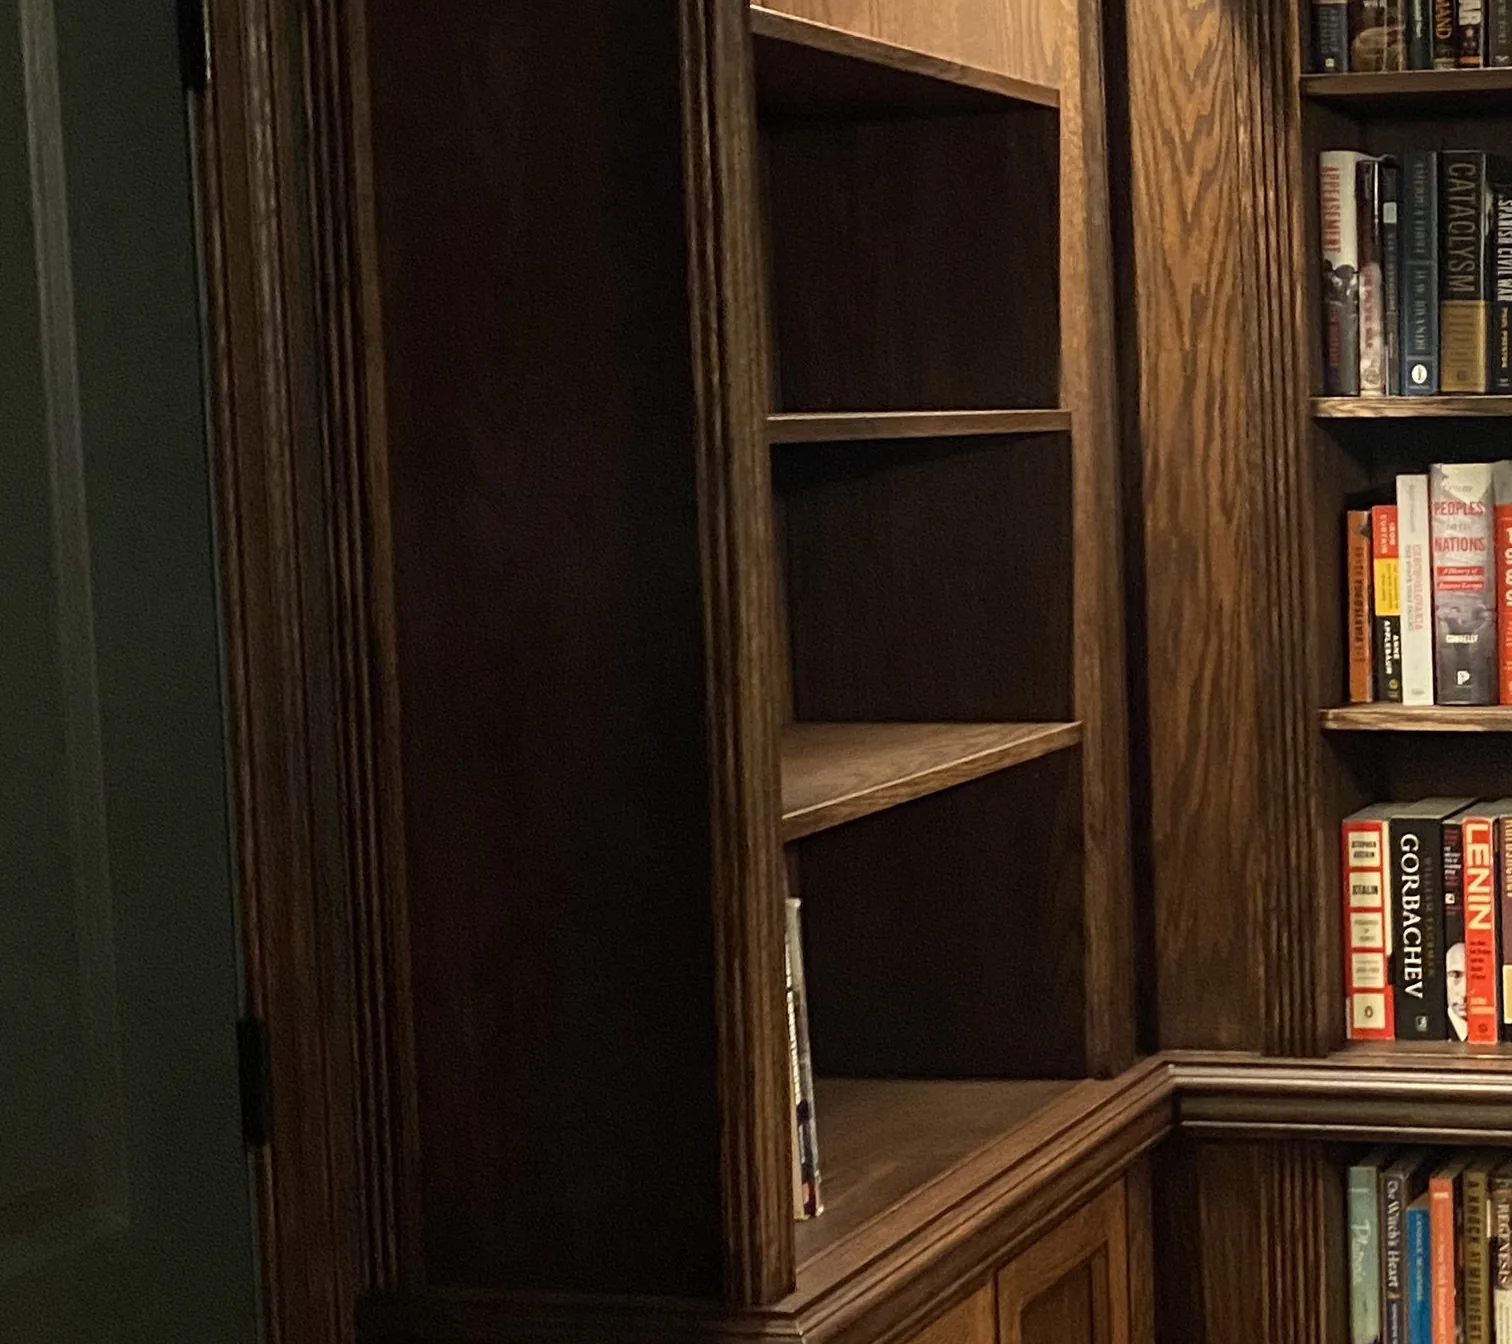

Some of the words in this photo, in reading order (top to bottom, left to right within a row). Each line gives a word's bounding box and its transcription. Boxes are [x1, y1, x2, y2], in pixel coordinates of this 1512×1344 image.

[1322, 167, 1341, 254] APPEASEMENT
[1447, 162, 1476, 293] CATACLYSM
[1433, 501, 1486, 516] PEOPLES
[1433, 537, 1487, 552] NATIONS
[1383, 620, 1393, 675] APPLEBAUM
[1352, 884, 1379, 895] STALIN
[1466, 823, 1493, 930] LENIN
[1398, 833, 1424, 999] GORBACHEV
[1387, 1249, 1399, 1288] Heart
[1497, 1202, 1511, 1285] REGENESIS
